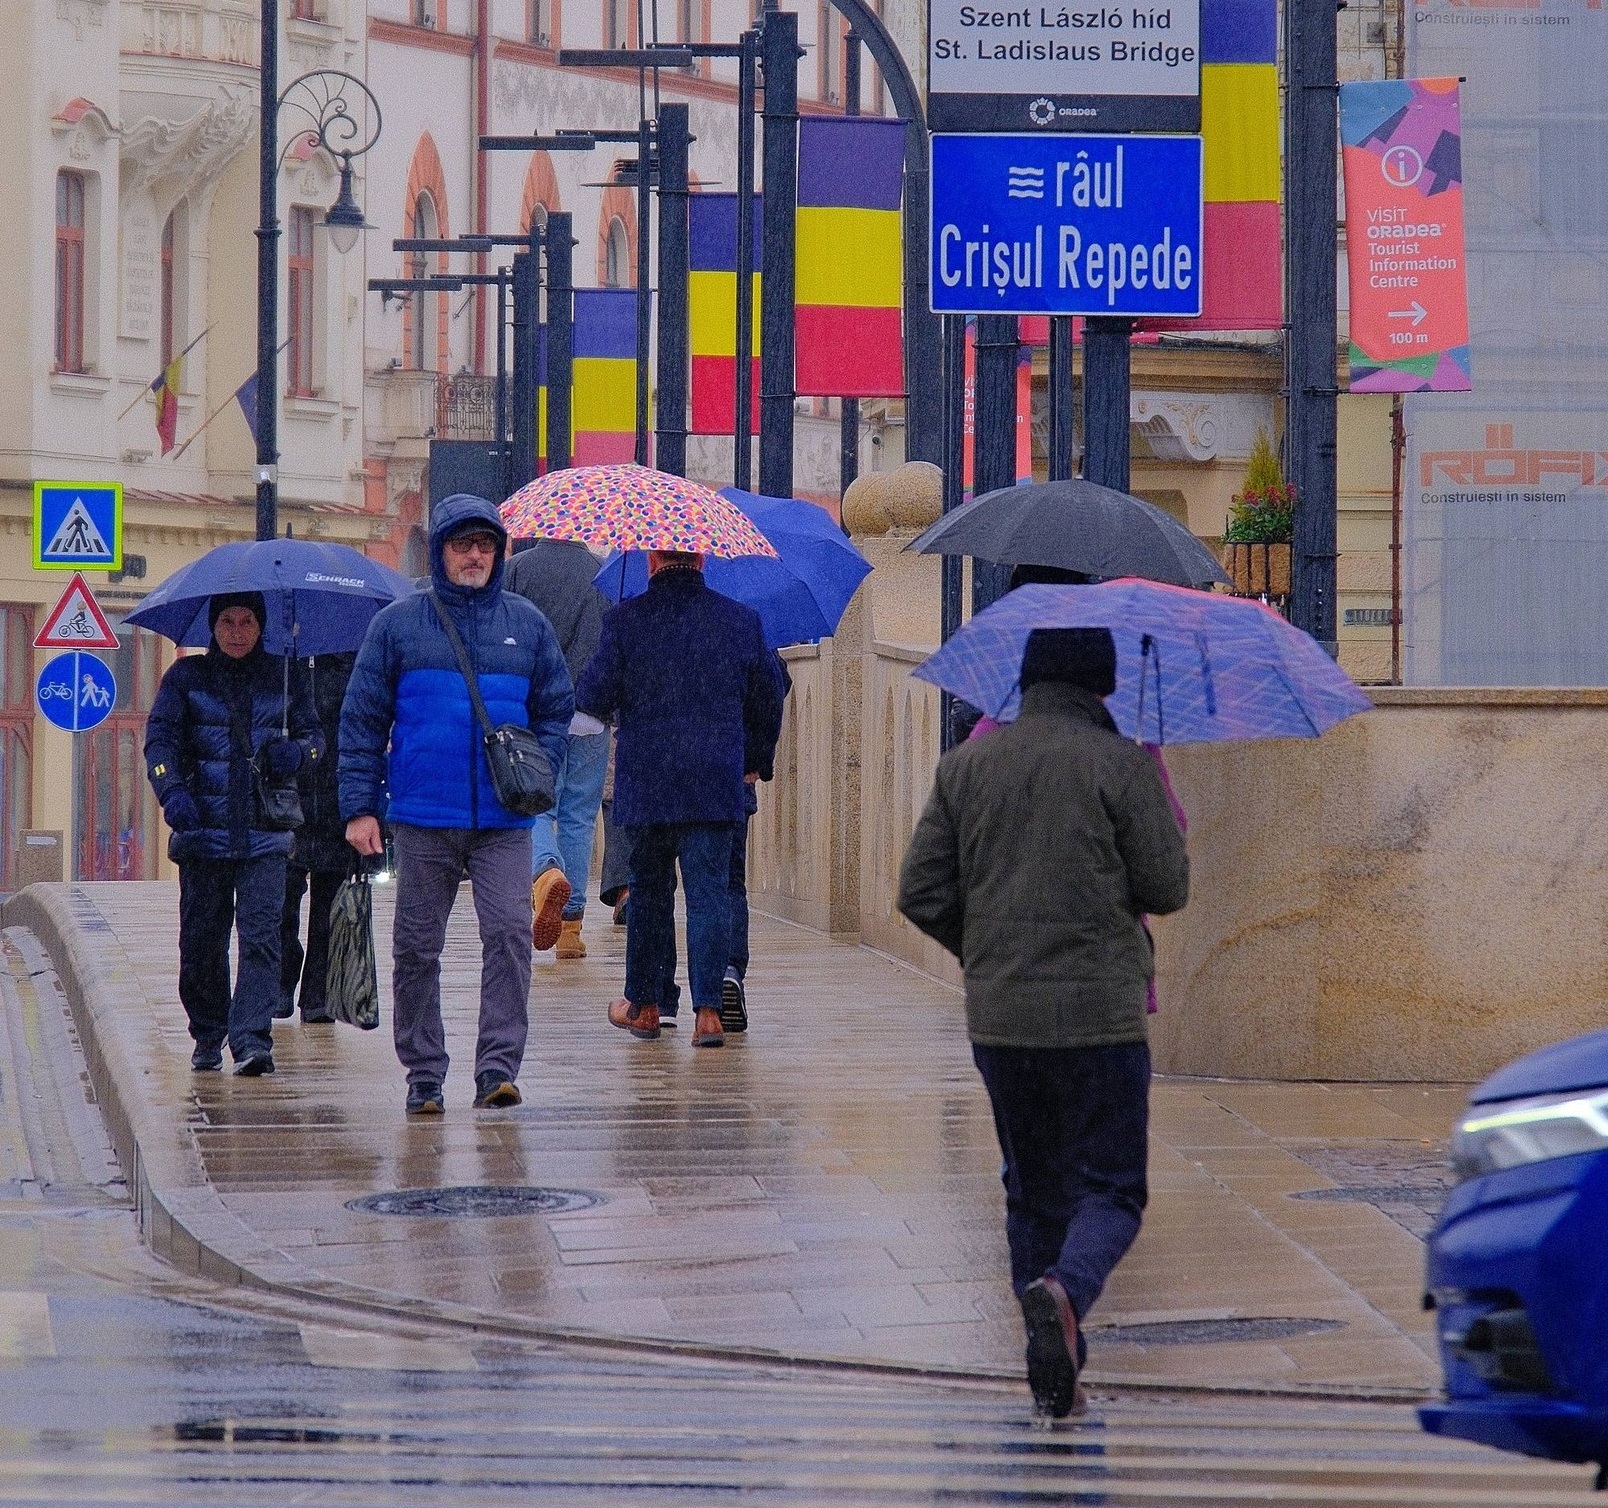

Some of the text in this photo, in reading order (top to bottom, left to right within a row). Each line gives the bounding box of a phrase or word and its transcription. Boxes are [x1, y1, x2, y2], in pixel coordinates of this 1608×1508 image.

[960, 7, 1171, 29] Szent László híd
[1522, 14, 1570, 25] sistem
[934, 39, 1195, 67] St. Ladislaus Bridge
[1056, 145, 1123, 208] râul
[1368, 240, 1420, 255] Tourist
[940, 224, 1192, 306] Crișul Repede
[1369, 256, 1457, 272] Information
[1370, 275, 1418, 288] Centre
[1389, 332, 1428, 344] 100 m
[1523, 492, 1566, 502] sistem
